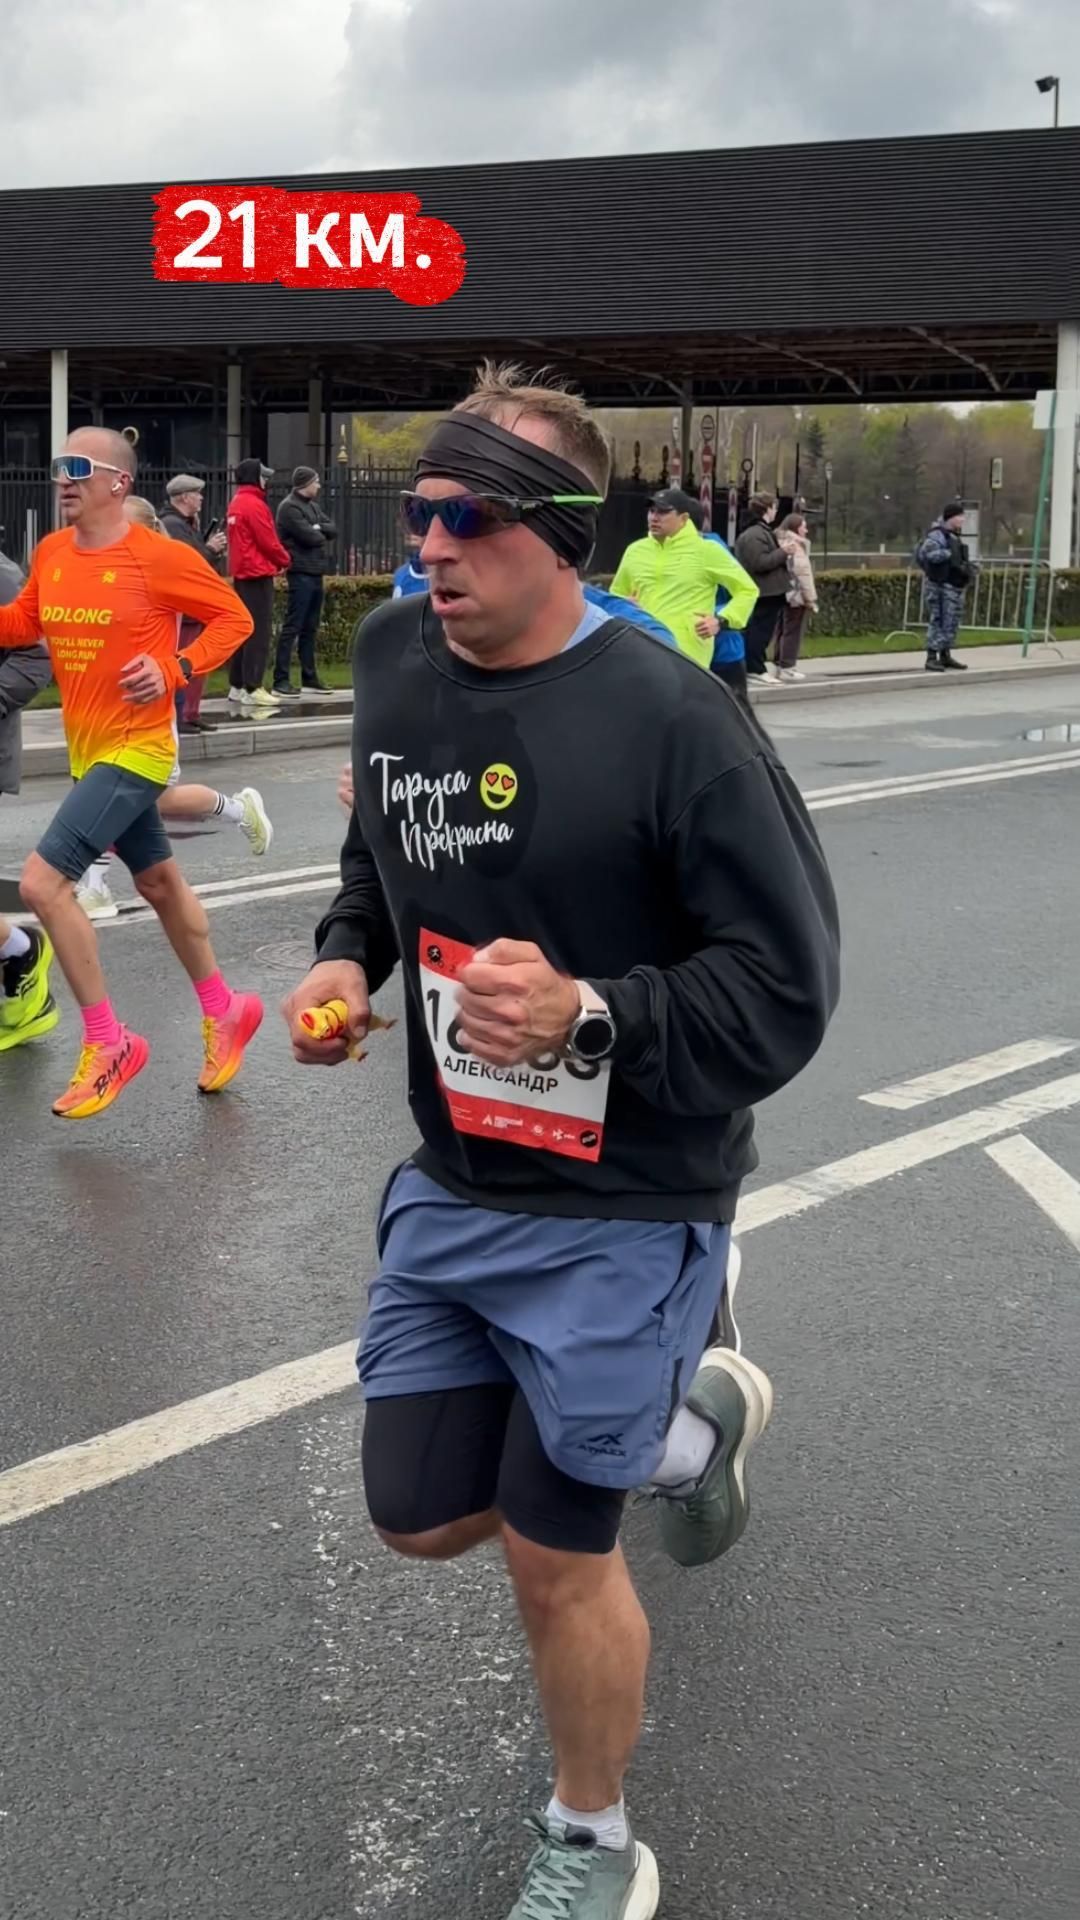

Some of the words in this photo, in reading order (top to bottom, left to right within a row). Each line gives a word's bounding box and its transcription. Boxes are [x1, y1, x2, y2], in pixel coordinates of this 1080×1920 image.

[57, 648, 78, 658] LONG
[79, 650, 97, 660] RUN
[77, 638, 104, 648] NEVER
[370, 752, 471, 830] Таруса
[400, 819, 514, 871] Прекрасна
[443, 1055, 559, 1093] АЛЕКСАНДР
